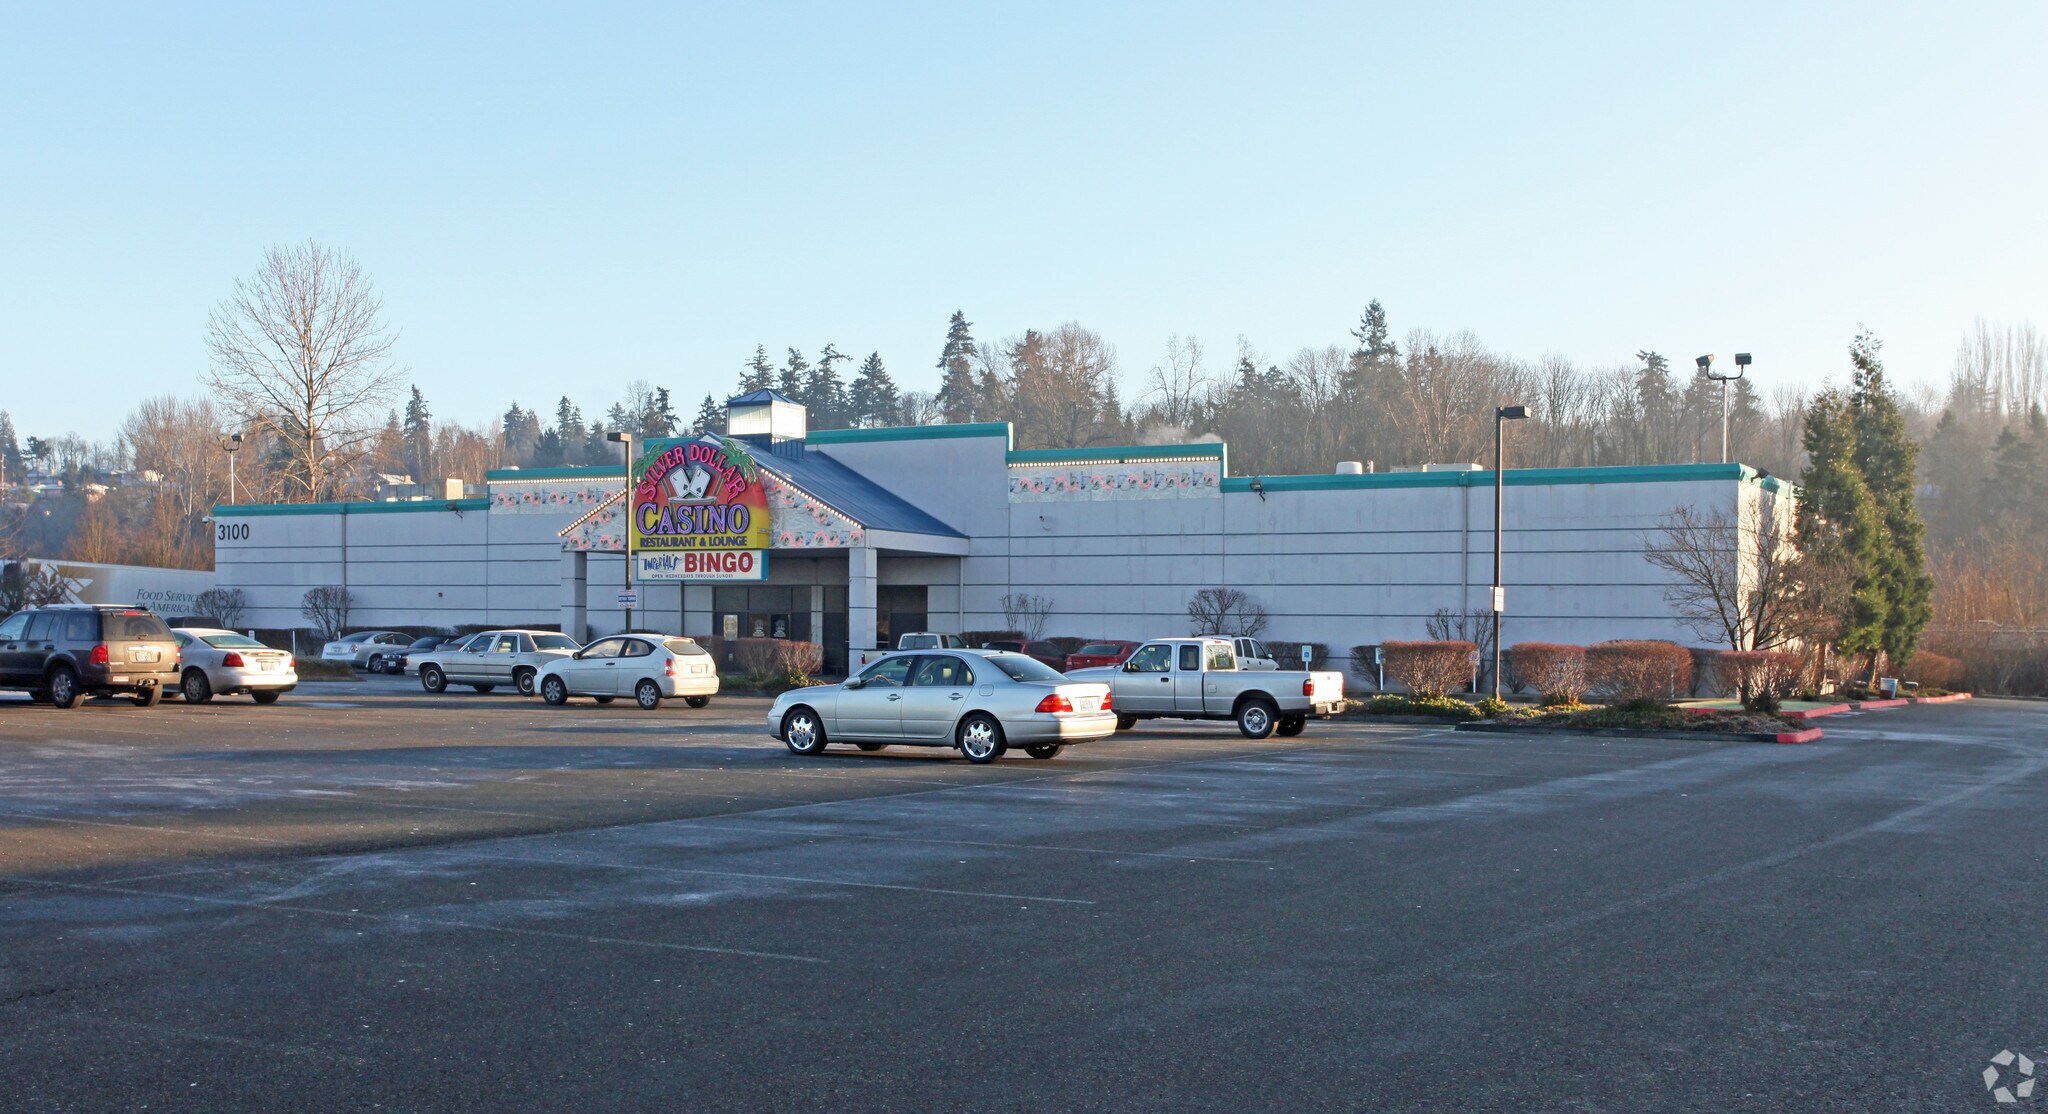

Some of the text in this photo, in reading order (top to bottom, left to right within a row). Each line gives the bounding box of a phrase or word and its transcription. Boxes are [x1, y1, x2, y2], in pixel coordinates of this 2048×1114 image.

[640, 444, 746, 503] SILVER DOLLAR
[636, 502, 750, 535] CASINO
[218, 523, 249, 541] 3100
[640, 535, 748, 548] RESTAURANT & LOUNGE
[684, 552, 754, 573] BINGO
[136, 588, 203, 603] FOOD SERVICE
[148, 601, 190, 614] AMERICA
